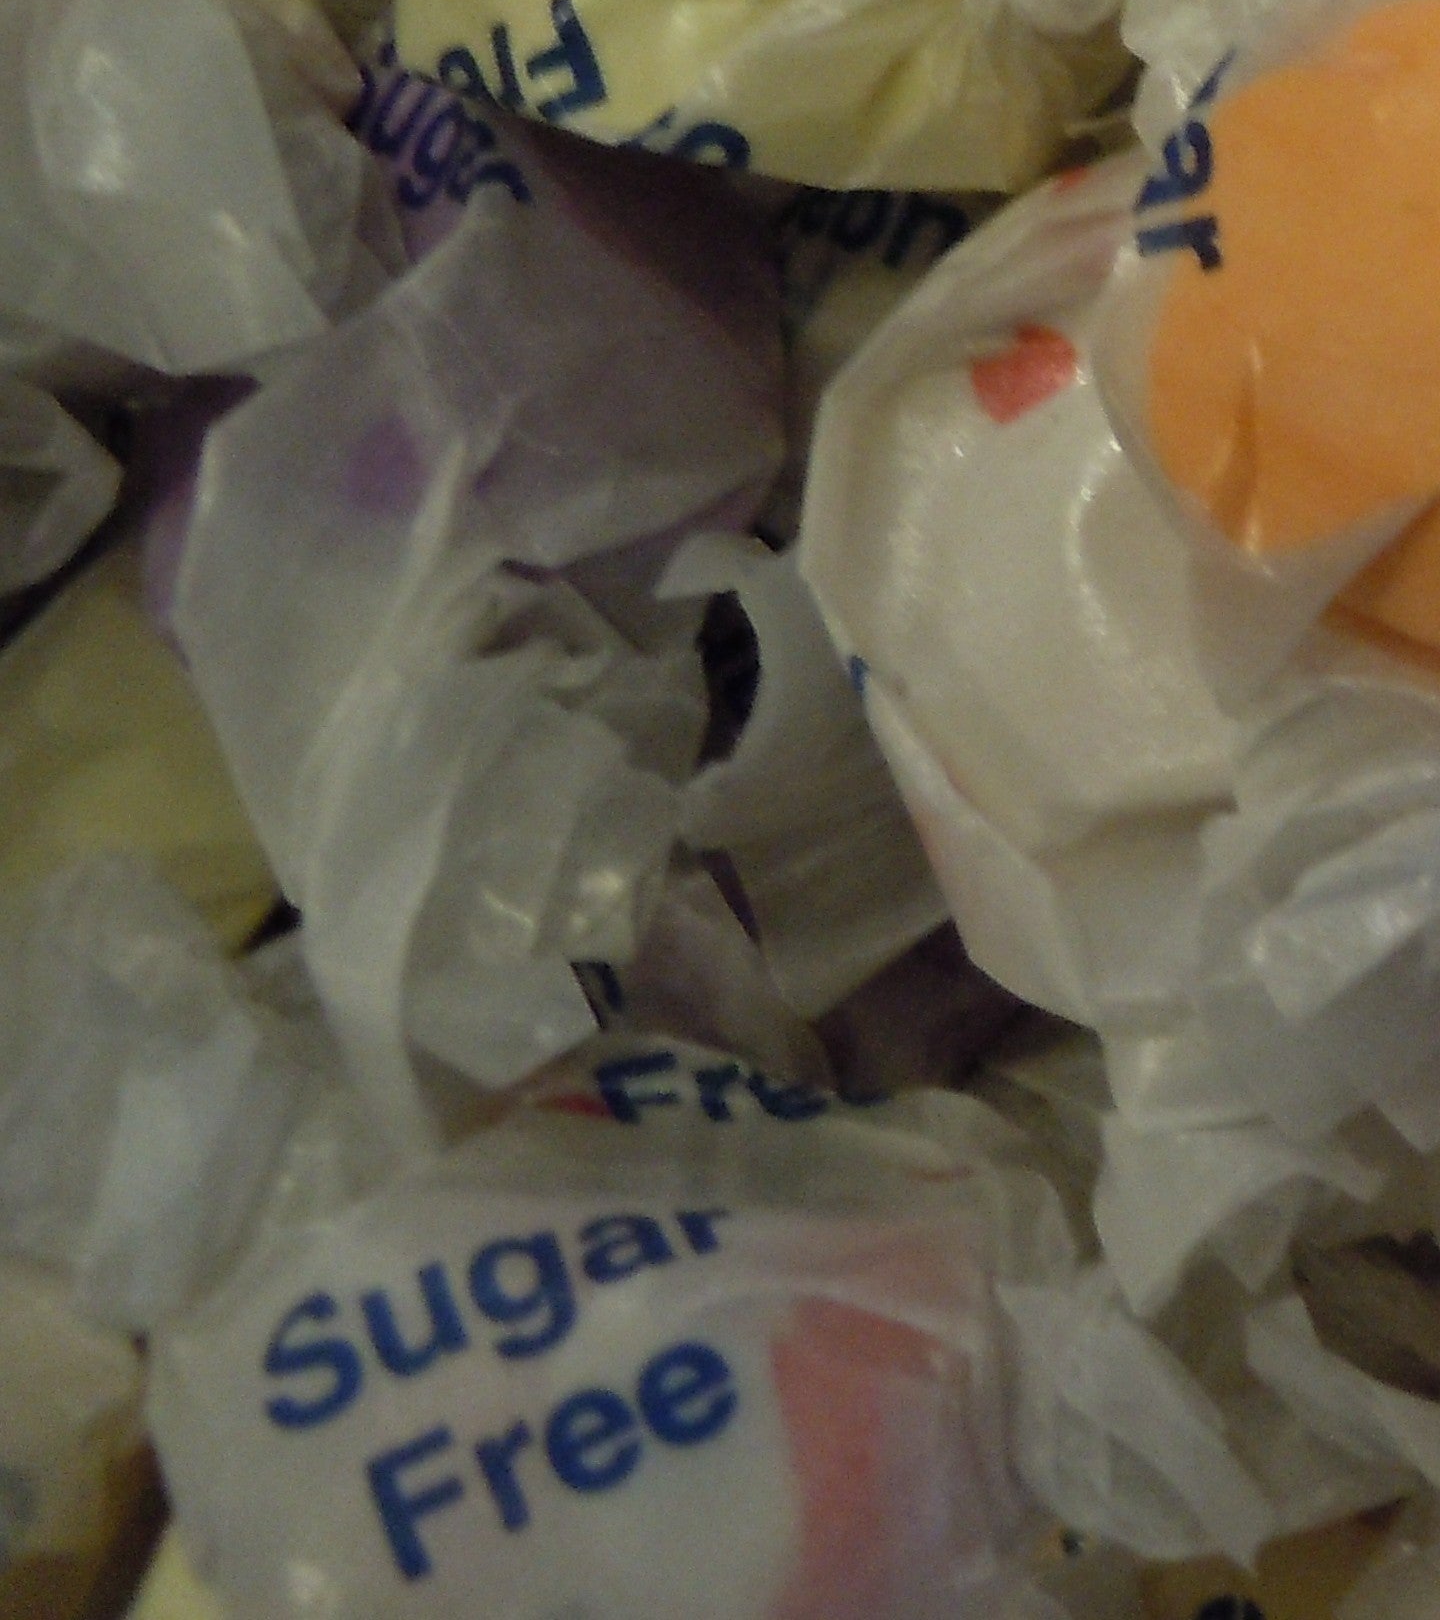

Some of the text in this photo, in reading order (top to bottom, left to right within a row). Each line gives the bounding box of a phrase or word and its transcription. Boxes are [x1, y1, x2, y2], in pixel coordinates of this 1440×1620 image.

[596, 1051, 892, 1125] Fre
[264, 1208, 730, 1430] Sugar
[366, 1340, 740, 1580] Free
